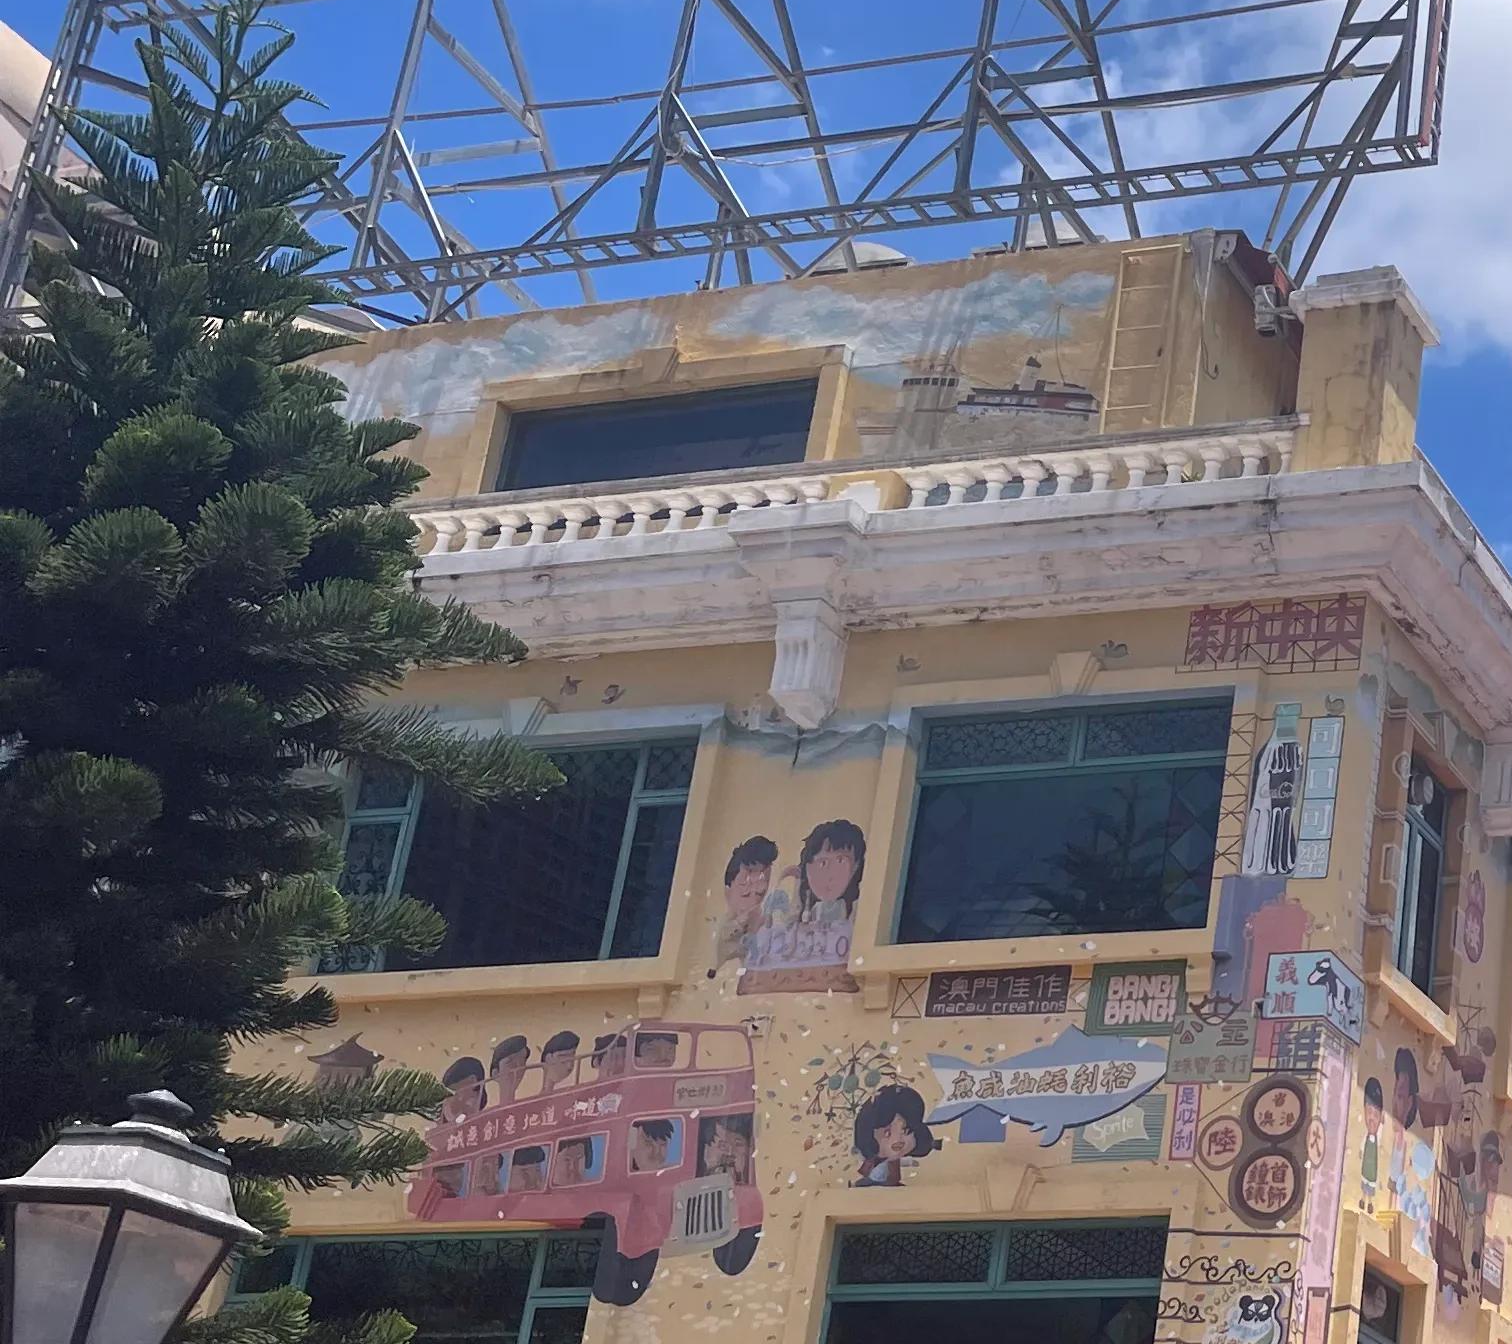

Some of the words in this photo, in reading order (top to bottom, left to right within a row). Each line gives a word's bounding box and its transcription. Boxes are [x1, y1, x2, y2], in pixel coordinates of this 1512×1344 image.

[1187, 593, 1364, 664] 新中央
[938, 973, 1066, 1001] 澳門佳作
[1107, 974, 1180, 1000] BANG!
[992, 998, 1066, 1014] creations
[1103, 999, 1175, 1026] BANG!
